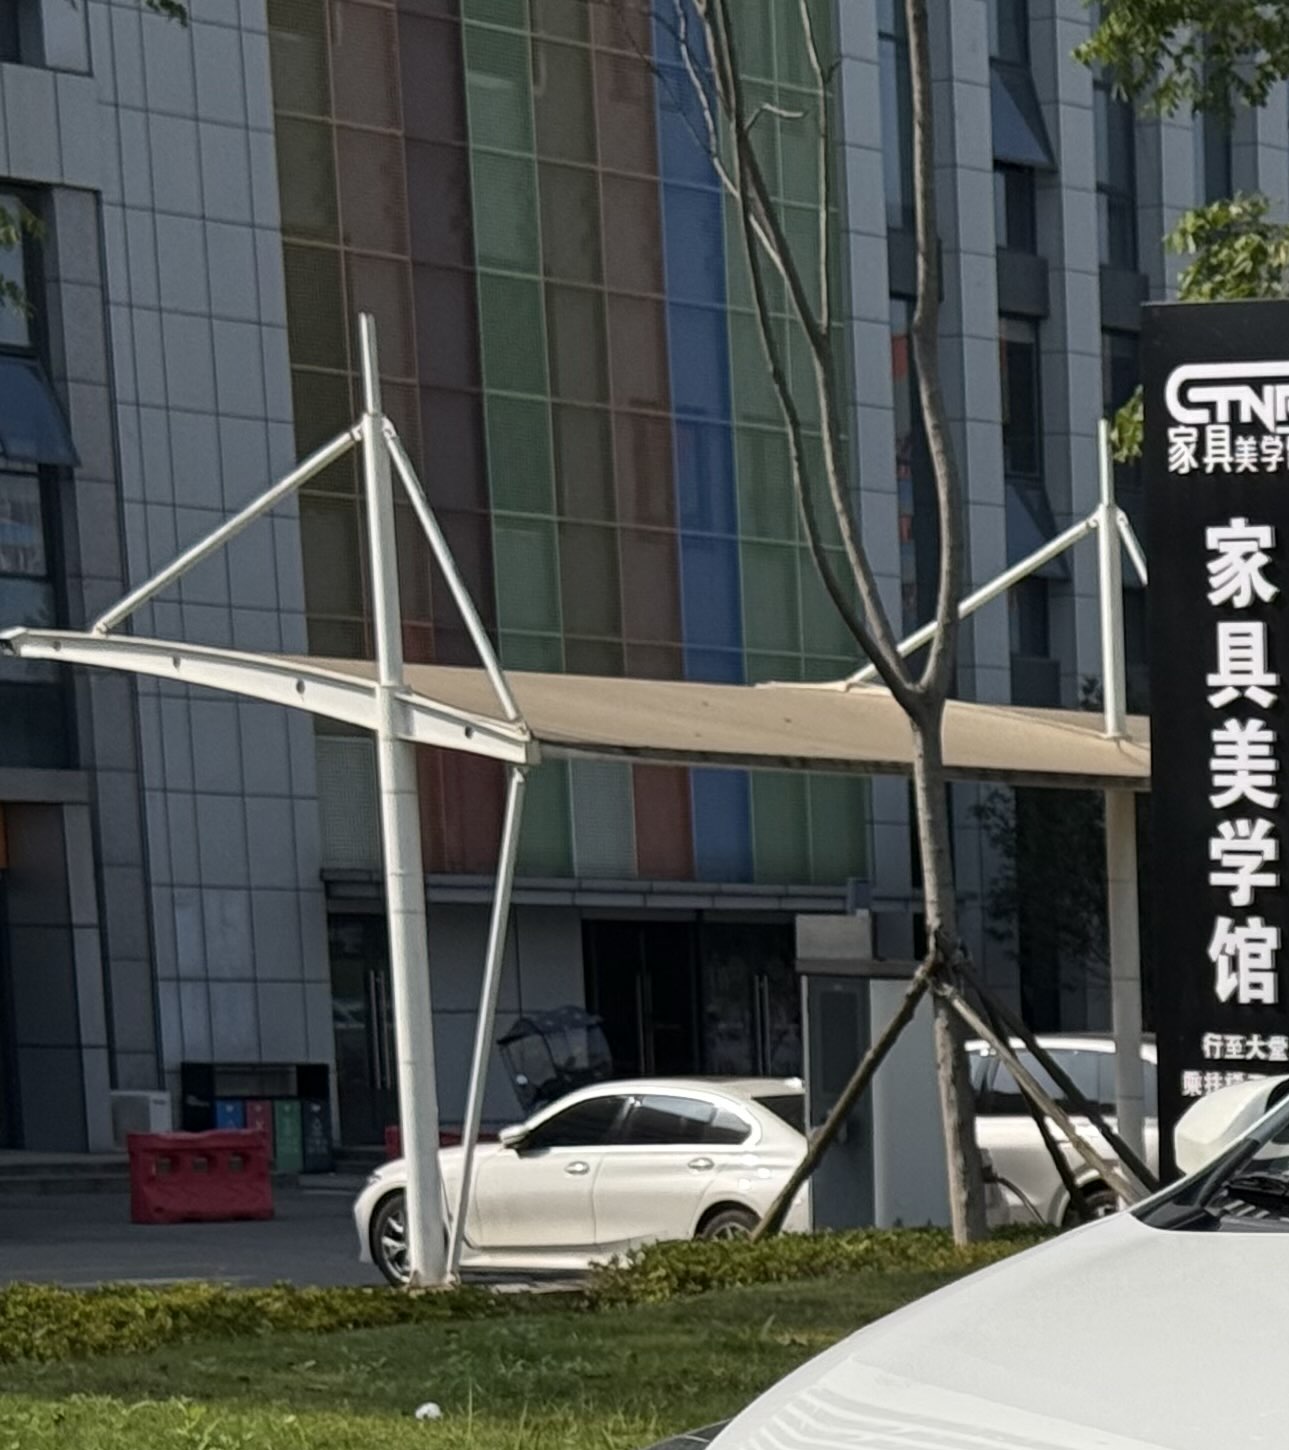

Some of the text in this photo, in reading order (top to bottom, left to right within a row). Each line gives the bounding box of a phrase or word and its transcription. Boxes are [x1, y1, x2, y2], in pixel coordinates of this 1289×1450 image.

[1206, 517, 1280, 1005] 家具美学馆
